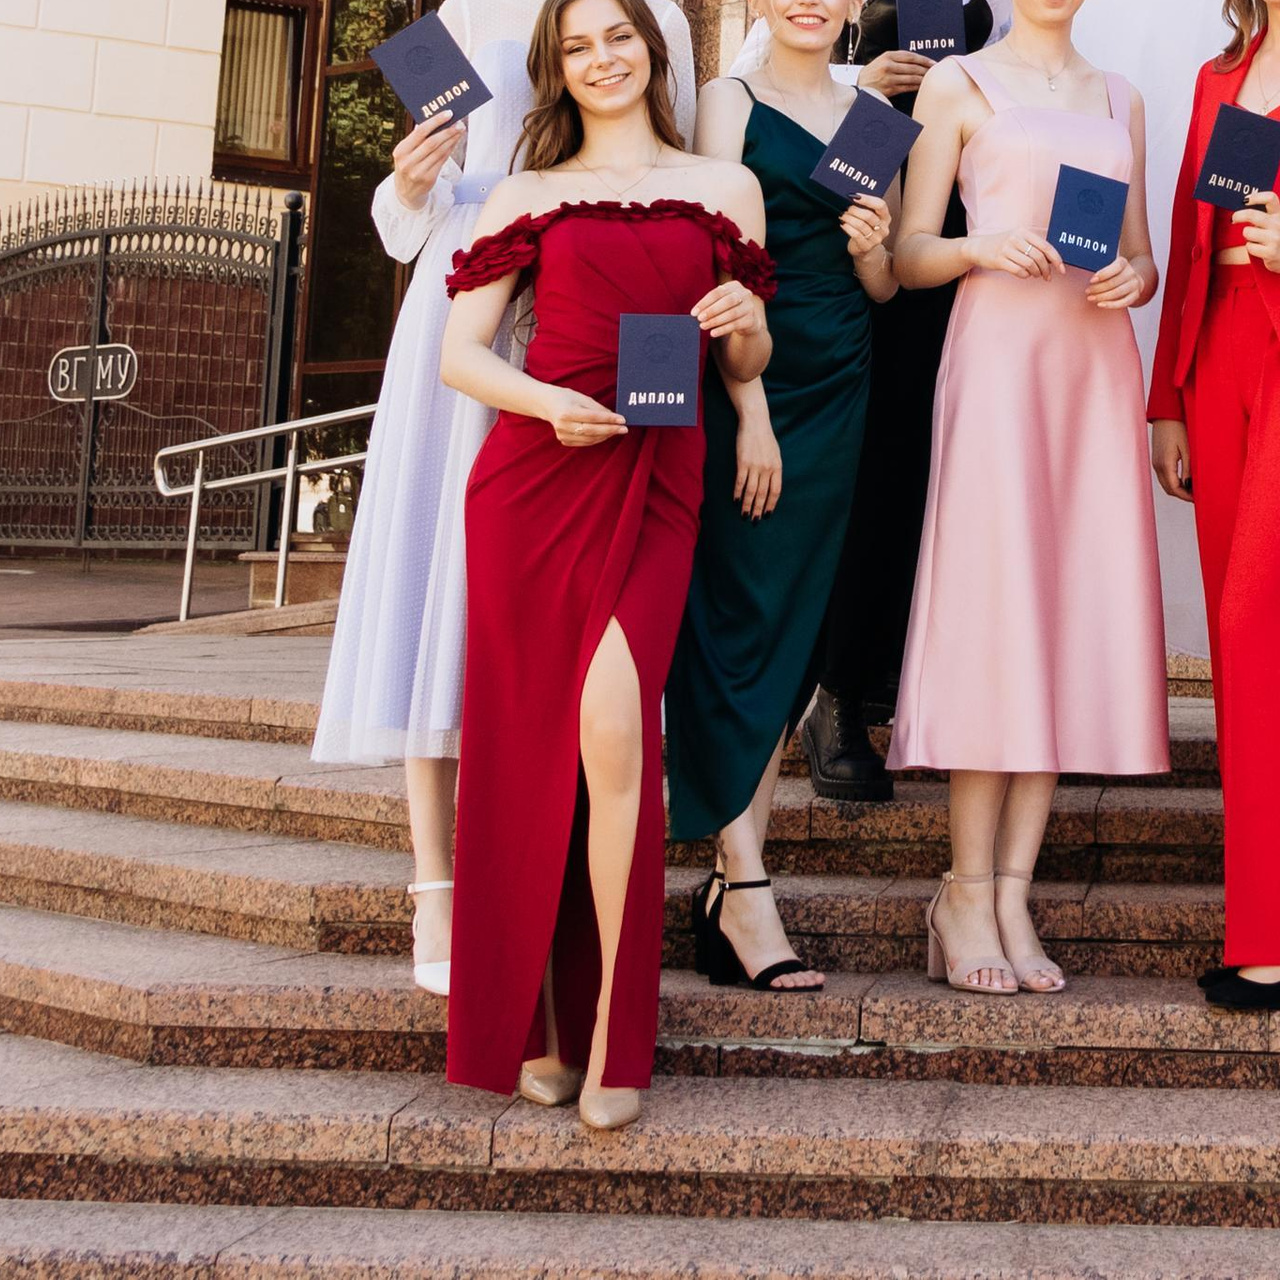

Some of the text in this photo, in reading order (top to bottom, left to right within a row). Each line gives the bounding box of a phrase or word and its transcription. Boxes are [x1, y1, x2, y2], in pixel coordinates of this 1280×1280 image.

[909, 38, 955, 51] ДЫПЛОМ
[421, 80, 470, 118] ДЫПЛОМ
[829, 158, 877, 190] ДЫПЛОМ
[1059, 231, 1107, 254] ДЫПЛОМ
[628, 391, 685, 406] ДЫПЛОМ
